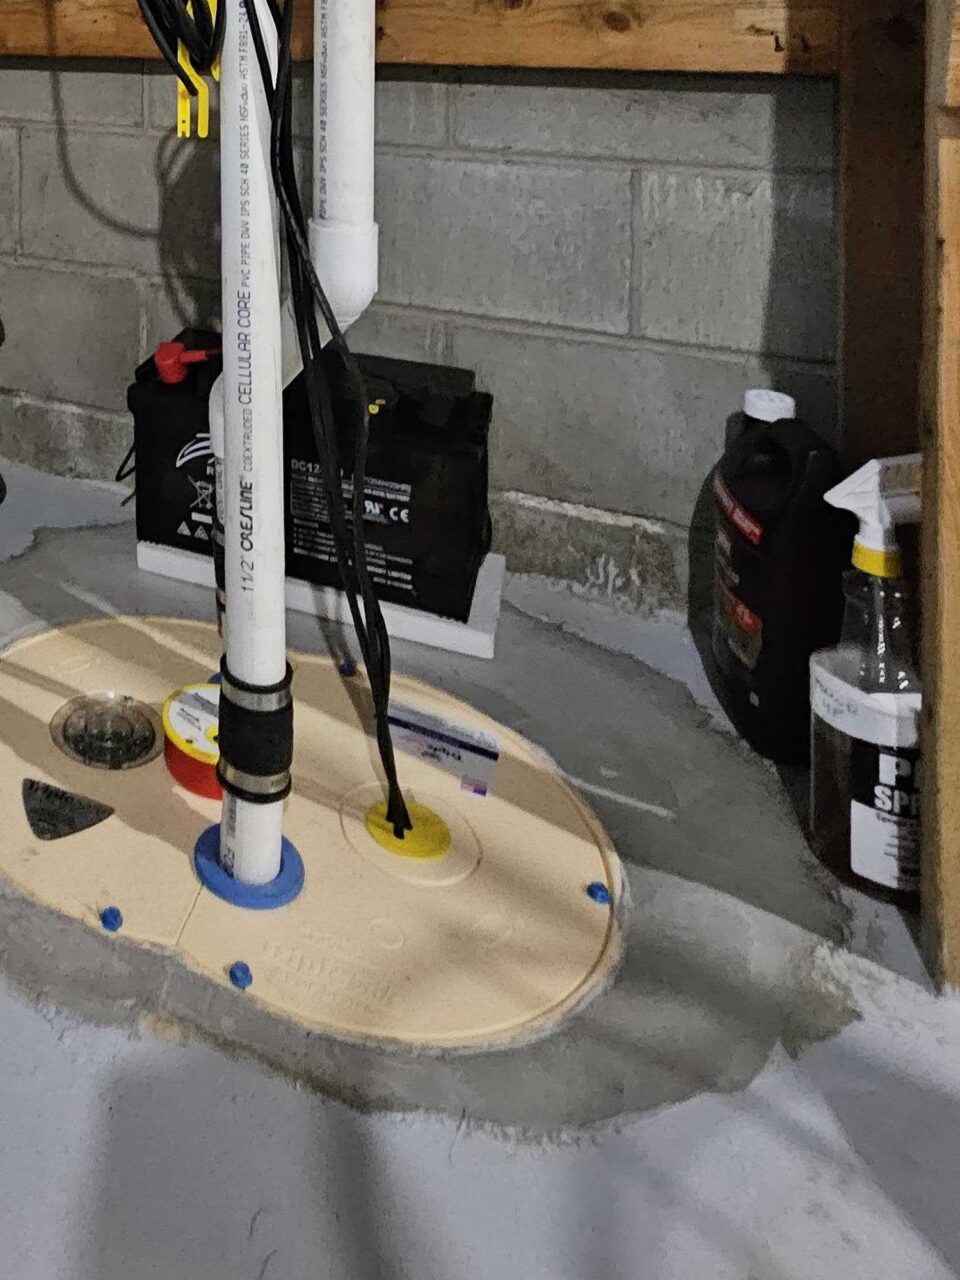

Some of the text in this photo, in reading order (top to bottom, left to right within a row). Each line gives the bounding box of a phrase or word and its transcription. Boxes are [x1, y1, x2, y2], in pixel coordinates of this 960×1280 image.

[240, 54, 249, 80] ASTM
[320, 82, 328, 117] SERIES
[240, 124, 250, 160] SERIES
[240, 163, 250, 176] 40
[240, 178, 250, 197] SCH
[240, 200, 250, 217] IPS
[241, 220, 250, 239] DWV
[241, 242, 250, 266] PIPE
[241, 268, 250, 288] PVC
[238, 290, 251, 329] CORE
[238, 332, 252, 405] CELLULAR
[243, 406, 253, 472] COEXTRUDED
[240, 479, 254, 552] CRESLINE
